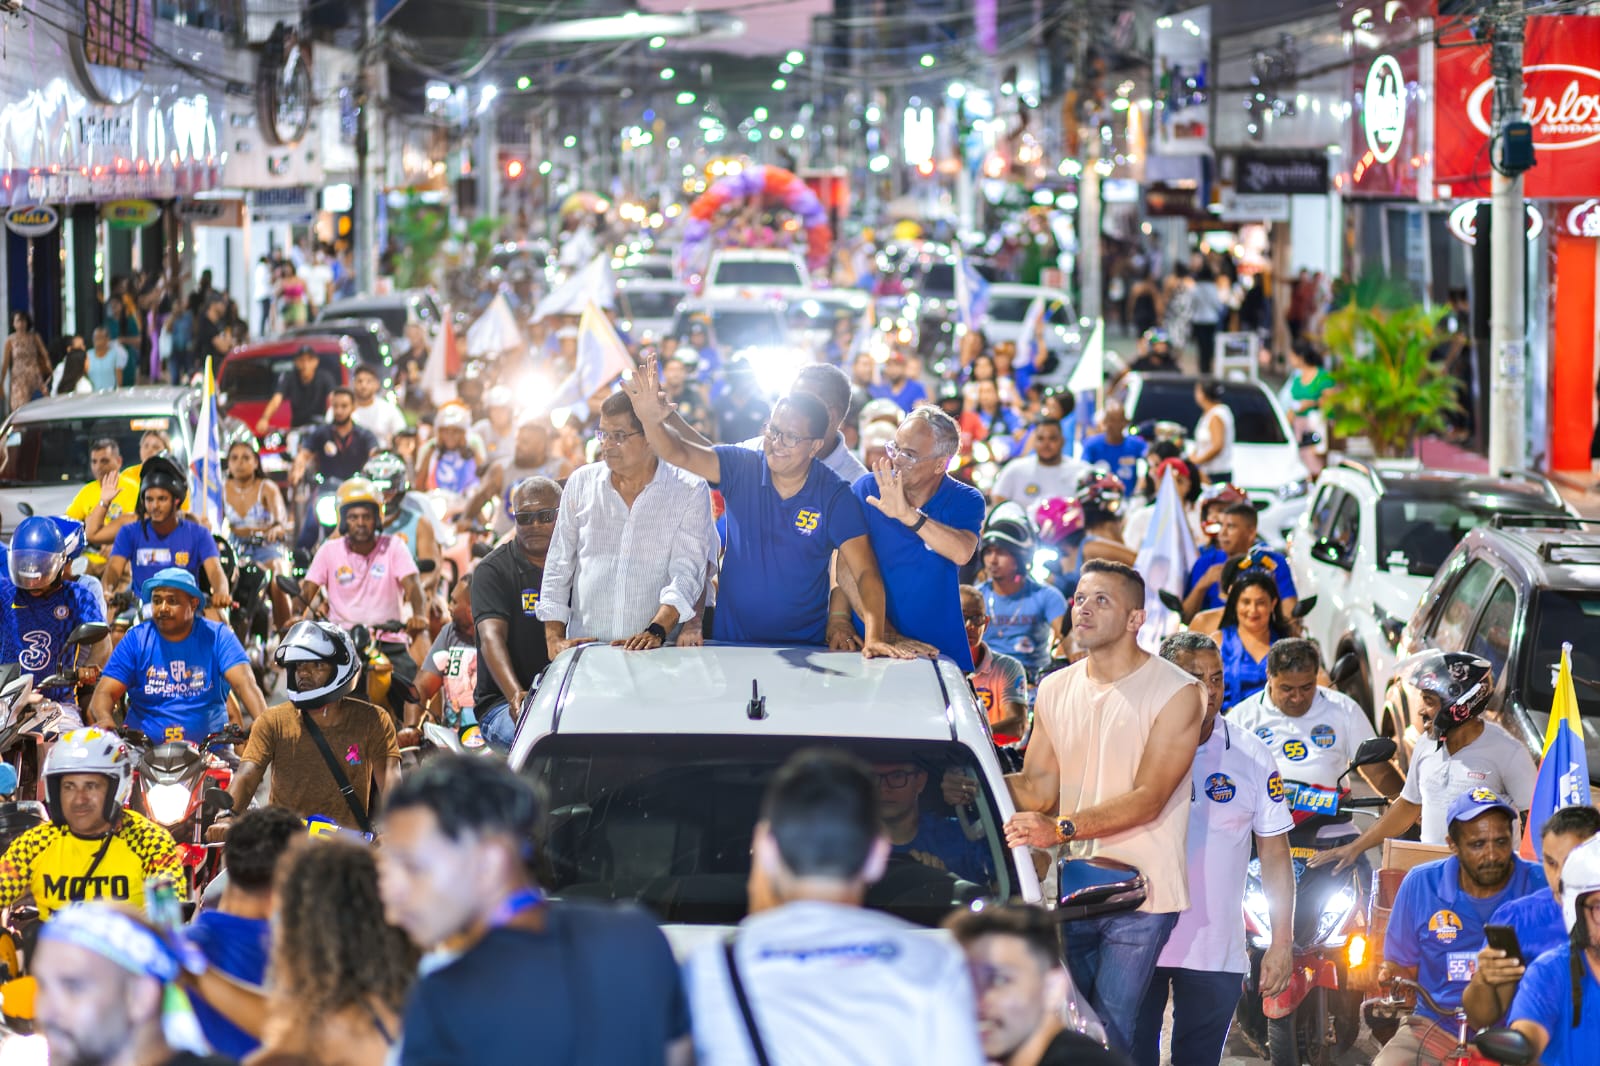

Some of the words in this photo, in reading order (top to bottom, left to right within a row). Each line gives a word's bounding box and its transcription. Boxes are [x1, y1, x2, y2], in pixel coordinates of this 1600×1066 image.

[11, 212, 50, 225] SKALA
[795, 509, 820, 530] 55
[19, 630, 52, 672] 3
[165, 726, 184, 743] 55
[1284, 741, 1305, 758] 55
[1268, 776, 1284, 797] 55
[43, 874, 129, 901] MOTO
[1449, 959, 1466, 974] 55
